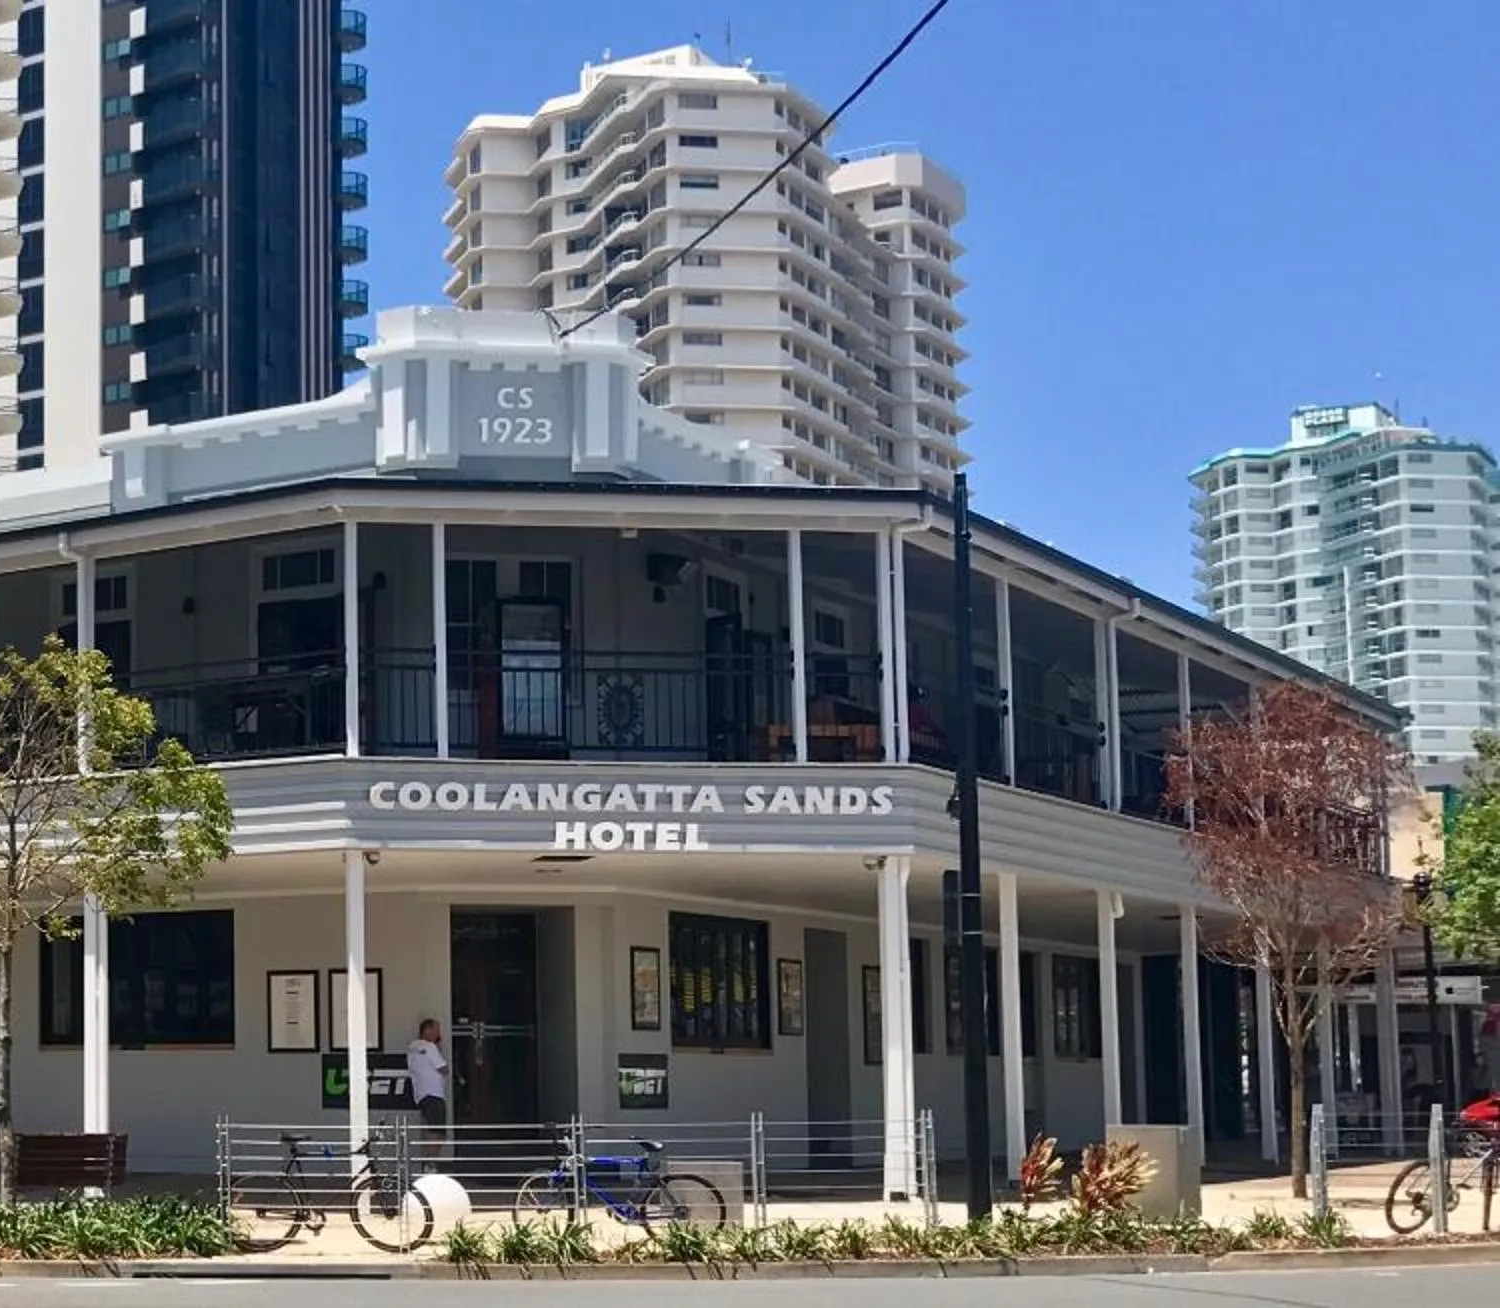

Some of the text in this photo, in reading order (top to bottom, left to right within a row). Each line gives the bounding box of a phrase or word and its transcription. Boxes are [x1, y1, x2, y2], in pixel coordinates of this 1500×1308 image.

[497, 387, 533, 409] CS
[479, 417, 552, 443] 1923
[369, 781, 894, 816] COOLANGATTA SANDS
[553, 821, 710, 852] HOTEL
[325, 1068, 410, 1095] UET
